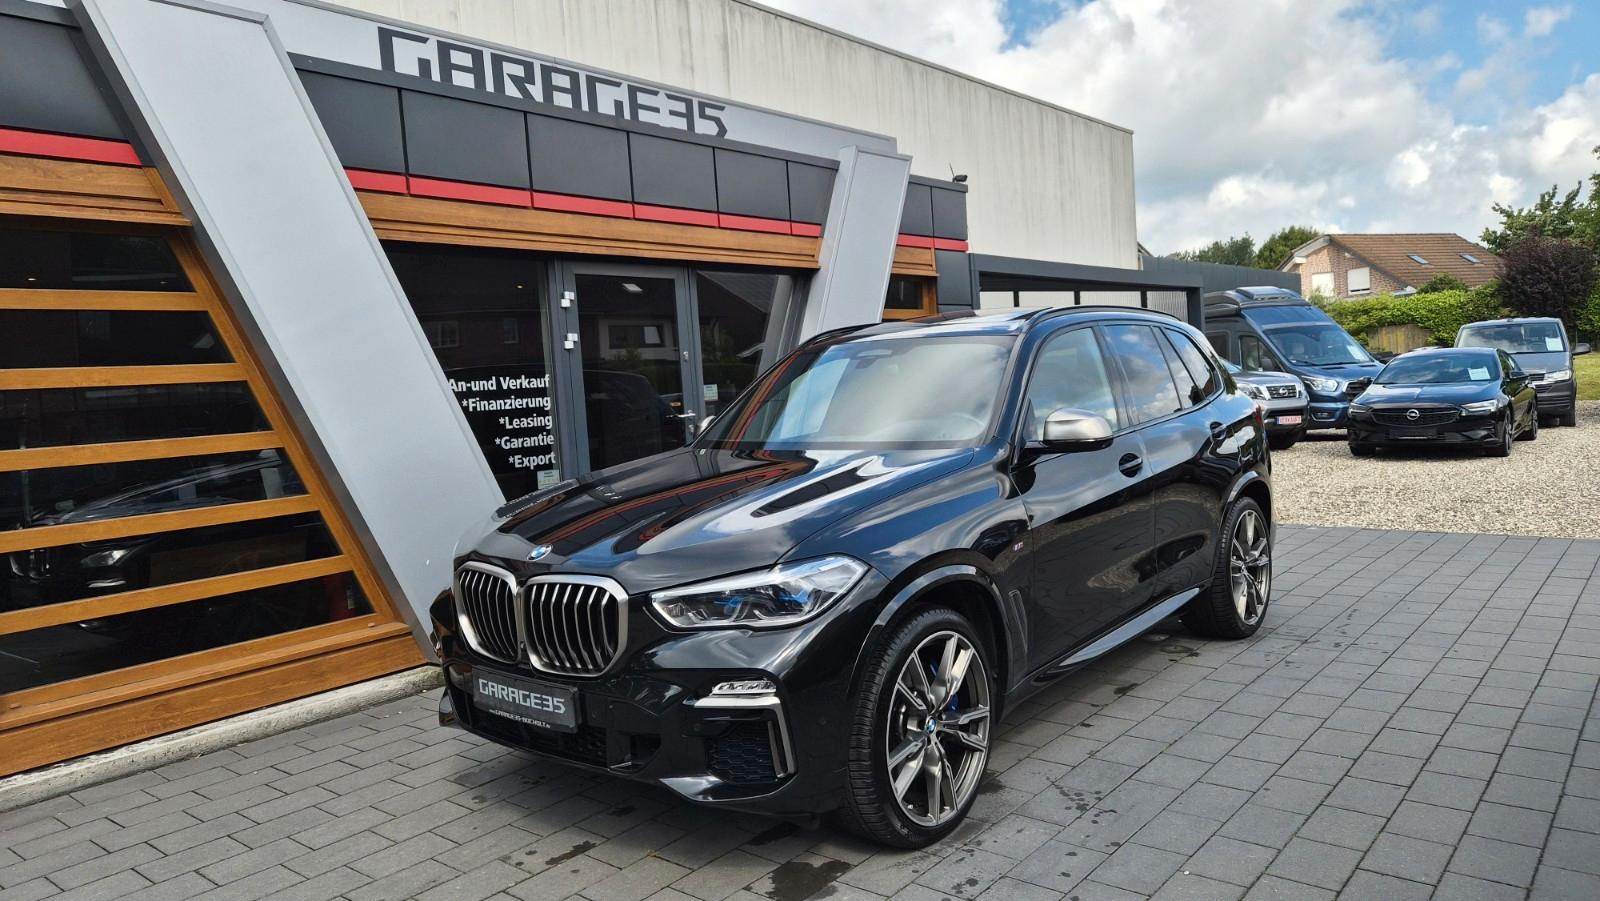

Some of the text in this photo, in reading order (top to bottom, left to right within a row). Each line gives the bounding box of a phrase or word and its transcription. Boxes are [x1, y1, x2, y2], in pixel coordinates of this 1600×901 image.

[377, 26, 728, 139] GARAGE35
[448, 374, 550, 392] An-und Verkauf
[478, 678, 566, 714] GARAGE35
